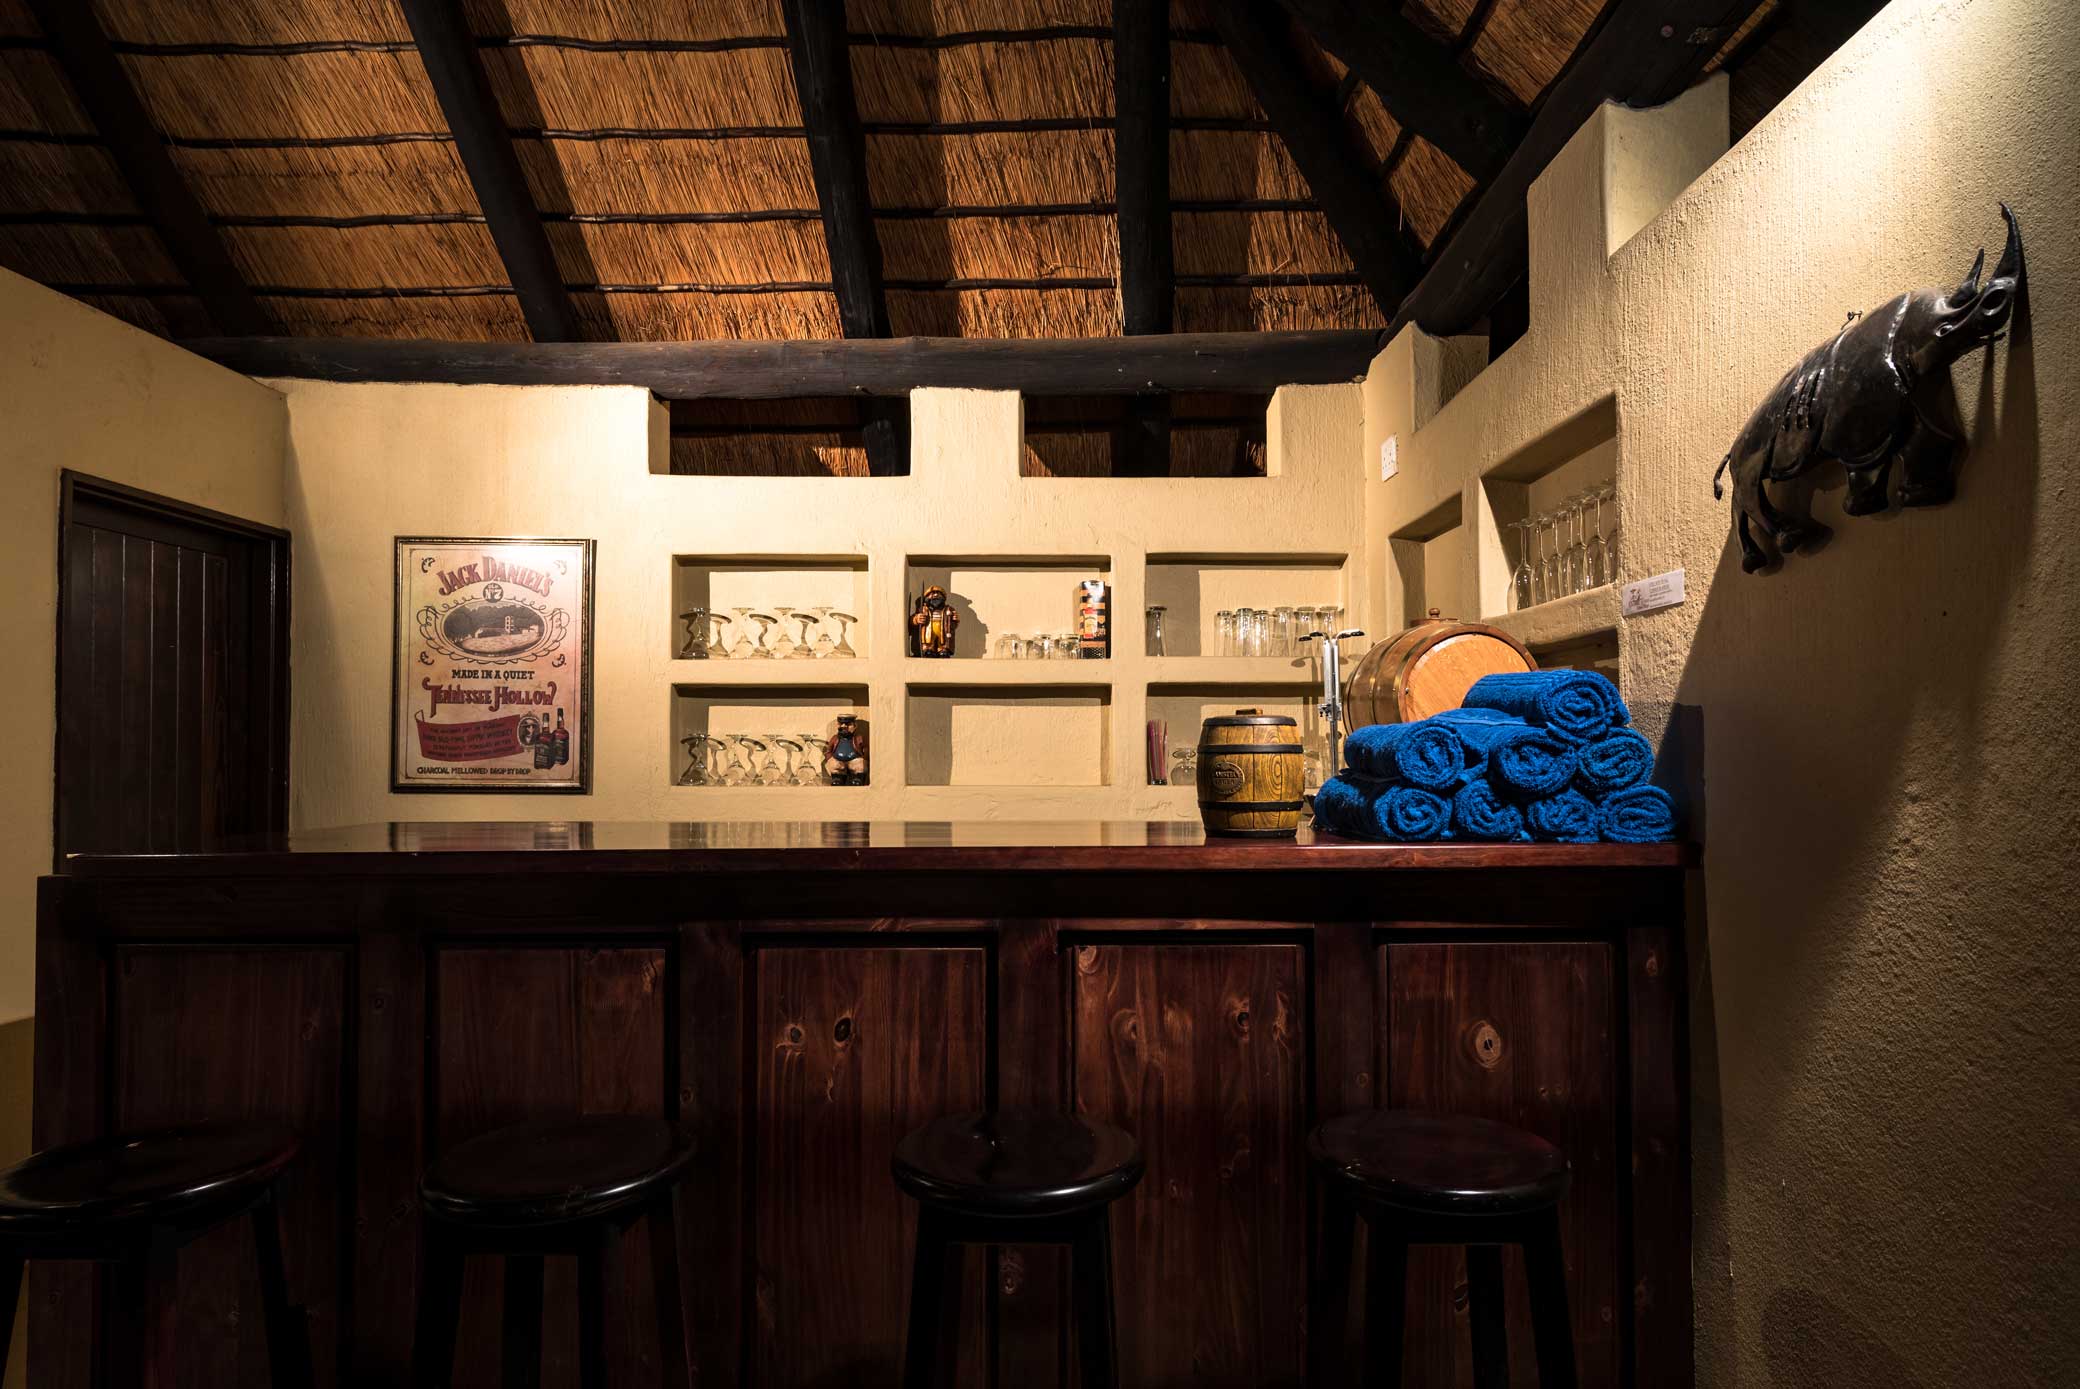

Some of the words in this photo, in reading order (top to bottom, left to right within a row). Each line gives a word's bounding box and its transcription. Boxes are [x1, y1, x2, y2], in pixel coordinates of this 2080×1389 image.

[436, 563, 482, 596] JACK
[482, 555, 554, 597] DANIEL'S
[451, 669, 480, 679] MADE
[481, 670, 494, 679] IN
[494, 670, 501, 679] A
[503, 670, 535, 681] QUIET
[488, 681, 557, 712] HOLLOW
[416, 766, 450, 775] CHARCOAL
[451, 766, 489, 775] MELLOWED
